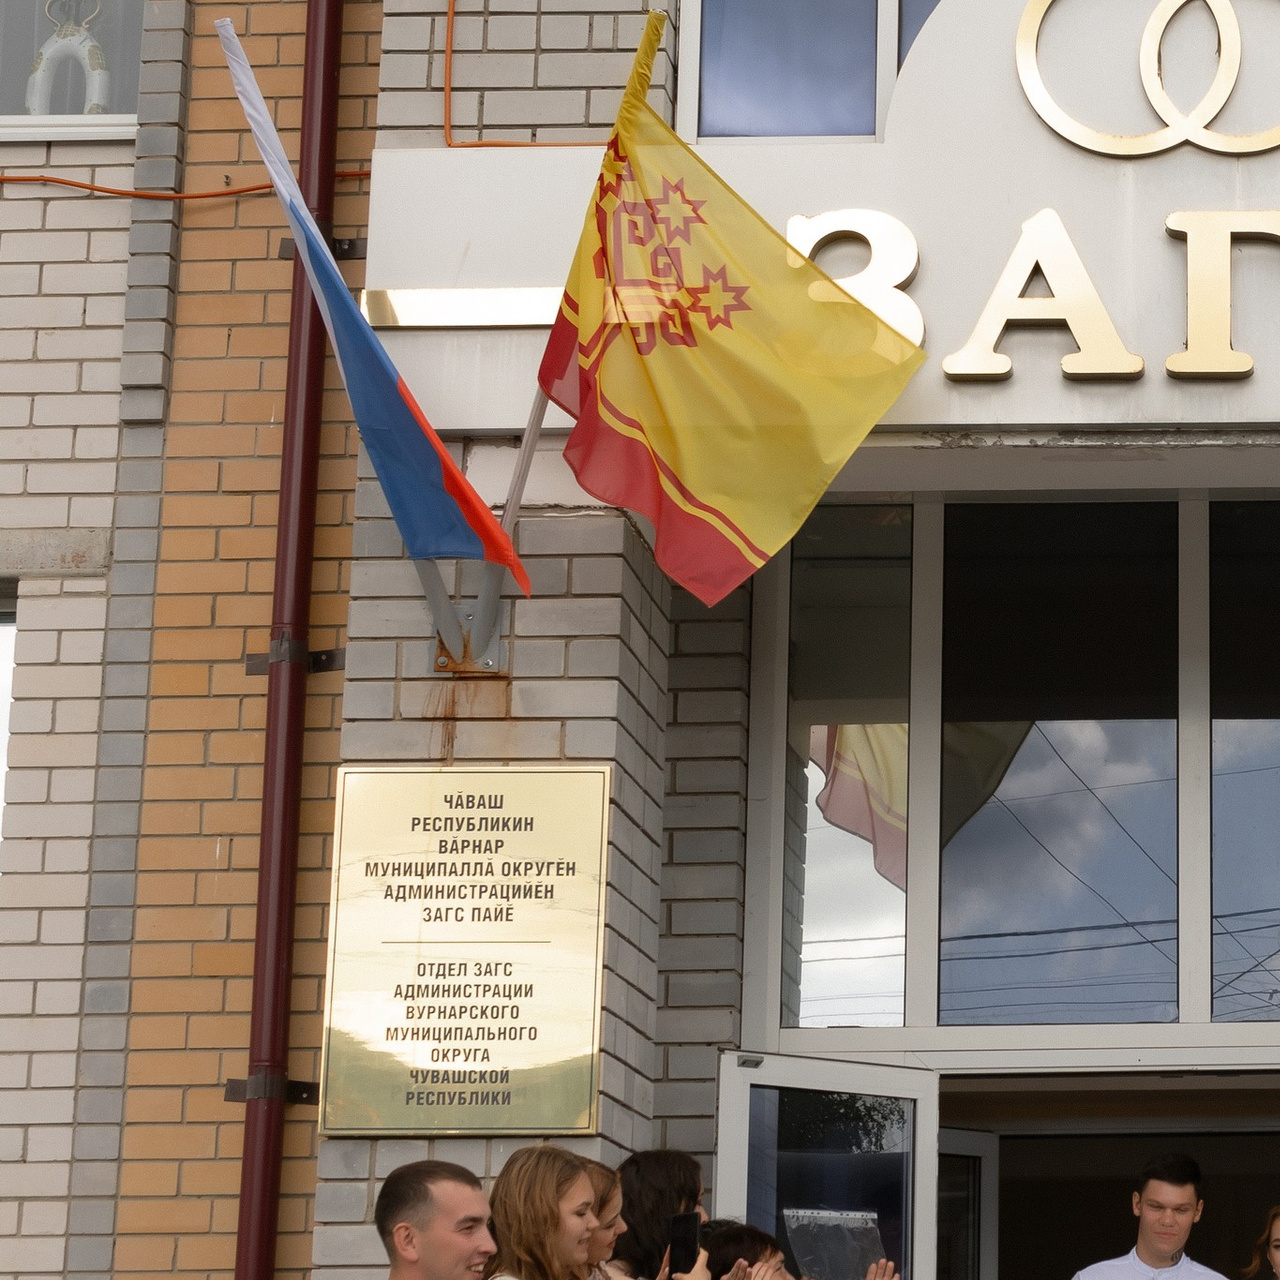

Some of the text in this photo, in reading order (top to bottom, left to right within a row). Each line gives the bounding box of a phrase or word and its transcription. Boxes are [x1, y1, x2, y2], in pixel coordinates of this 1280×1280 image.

[412, 817, 534, 832] РЕСПУБЛИКИН
[423, 907, 464, 922] ЗАГС
[417, 962, 513, 980] ОТДЕЛ ЗАГС
[394, 984, 533, 1001] АДМИНИСТРАЦИИ
[406, 1005, 519, 1020] ВУРНАРСКОГО
[386, 1026, 537, 1043] МУНИЦИПАЛЬНОГО
[431, 1048, 490, 1063] ОКРУГА
[410, 1065, 509, 1084] ЧУВАШСКОЙ
[406, 1091, 511, 1106] РЕСПУБЛИКИ
